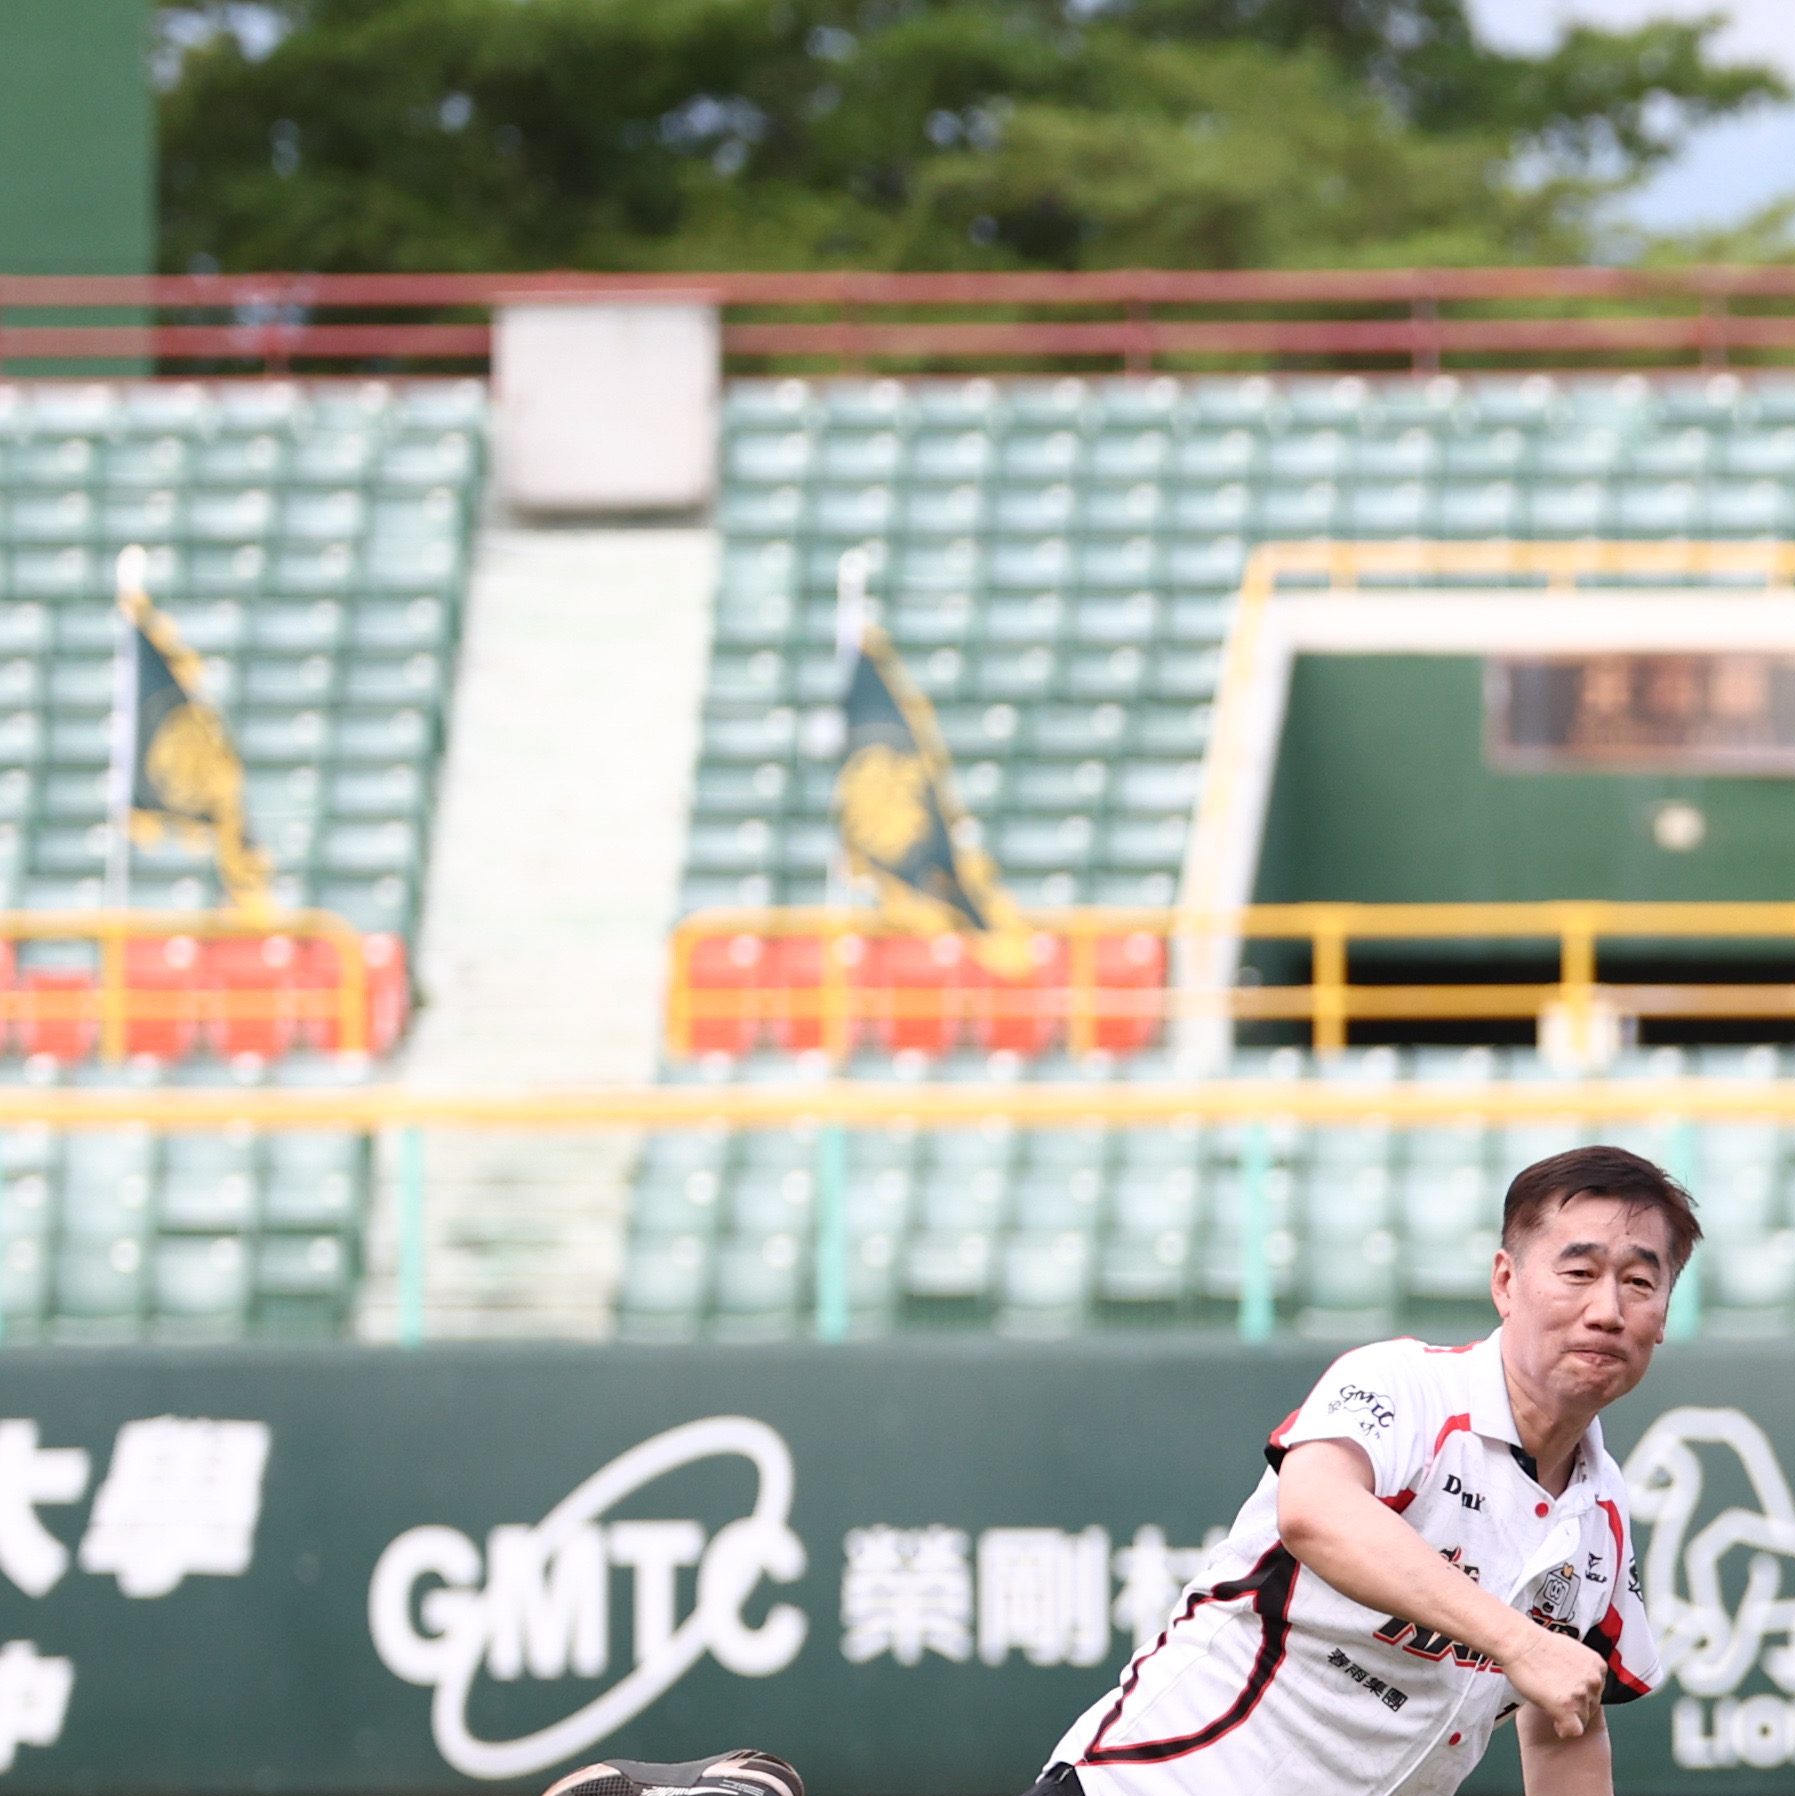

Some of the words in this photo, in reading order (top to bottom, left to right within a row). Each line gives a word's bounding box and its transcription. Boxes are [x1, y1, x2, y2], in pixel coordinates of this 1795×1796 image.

[368, 1520, 808, 1686] GMTC
[1327, 1648, 1409, 1712] 春雨集團
